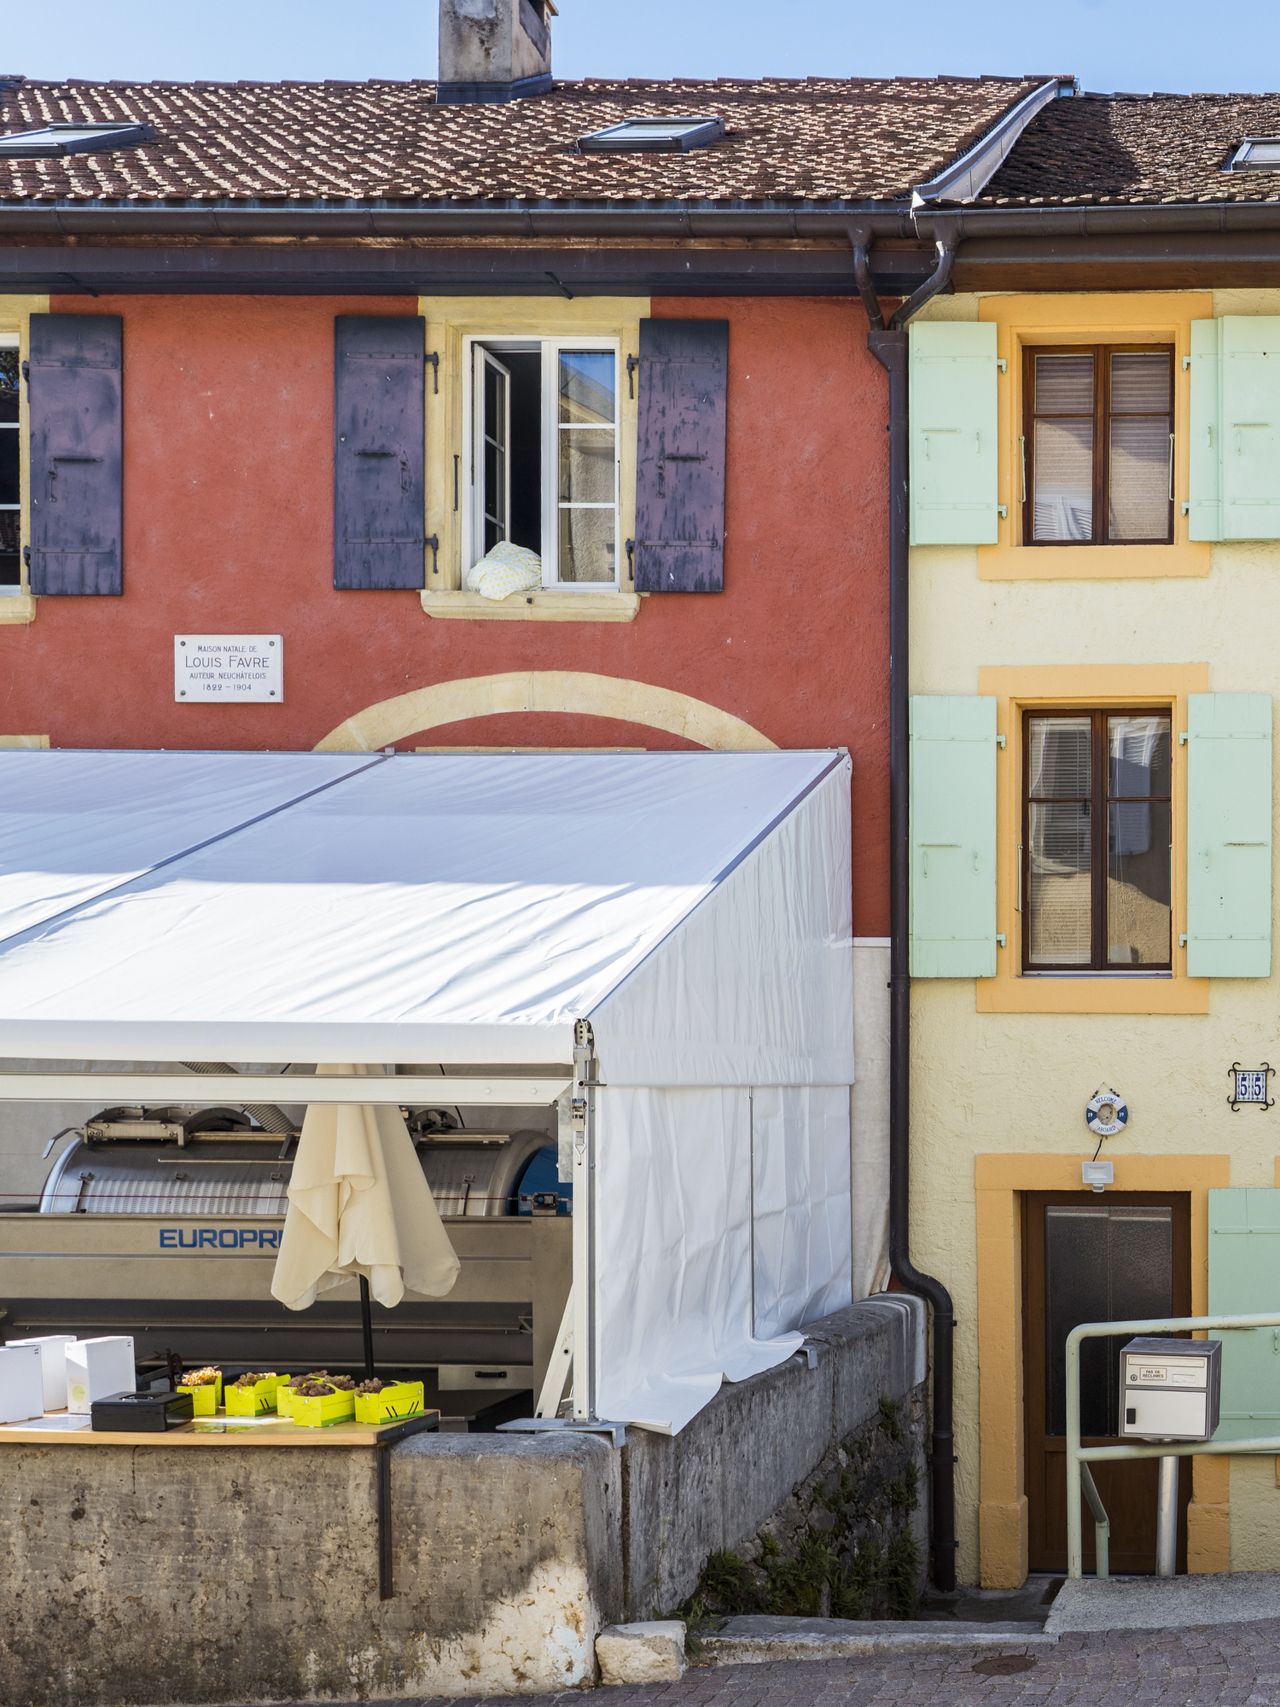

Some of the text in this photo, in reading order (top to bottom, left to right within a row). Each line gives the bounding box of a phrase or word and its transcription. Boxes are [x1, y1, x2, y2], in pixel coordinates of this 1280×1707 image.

[185, 655, 270, 668] LOUIS FAVRE
[218, 671, 266, 680] NEUCHÂTELOIS
[1240, 1076, 1262, 1096] 55
[160, 1229, 284, 1248] EUROPR
